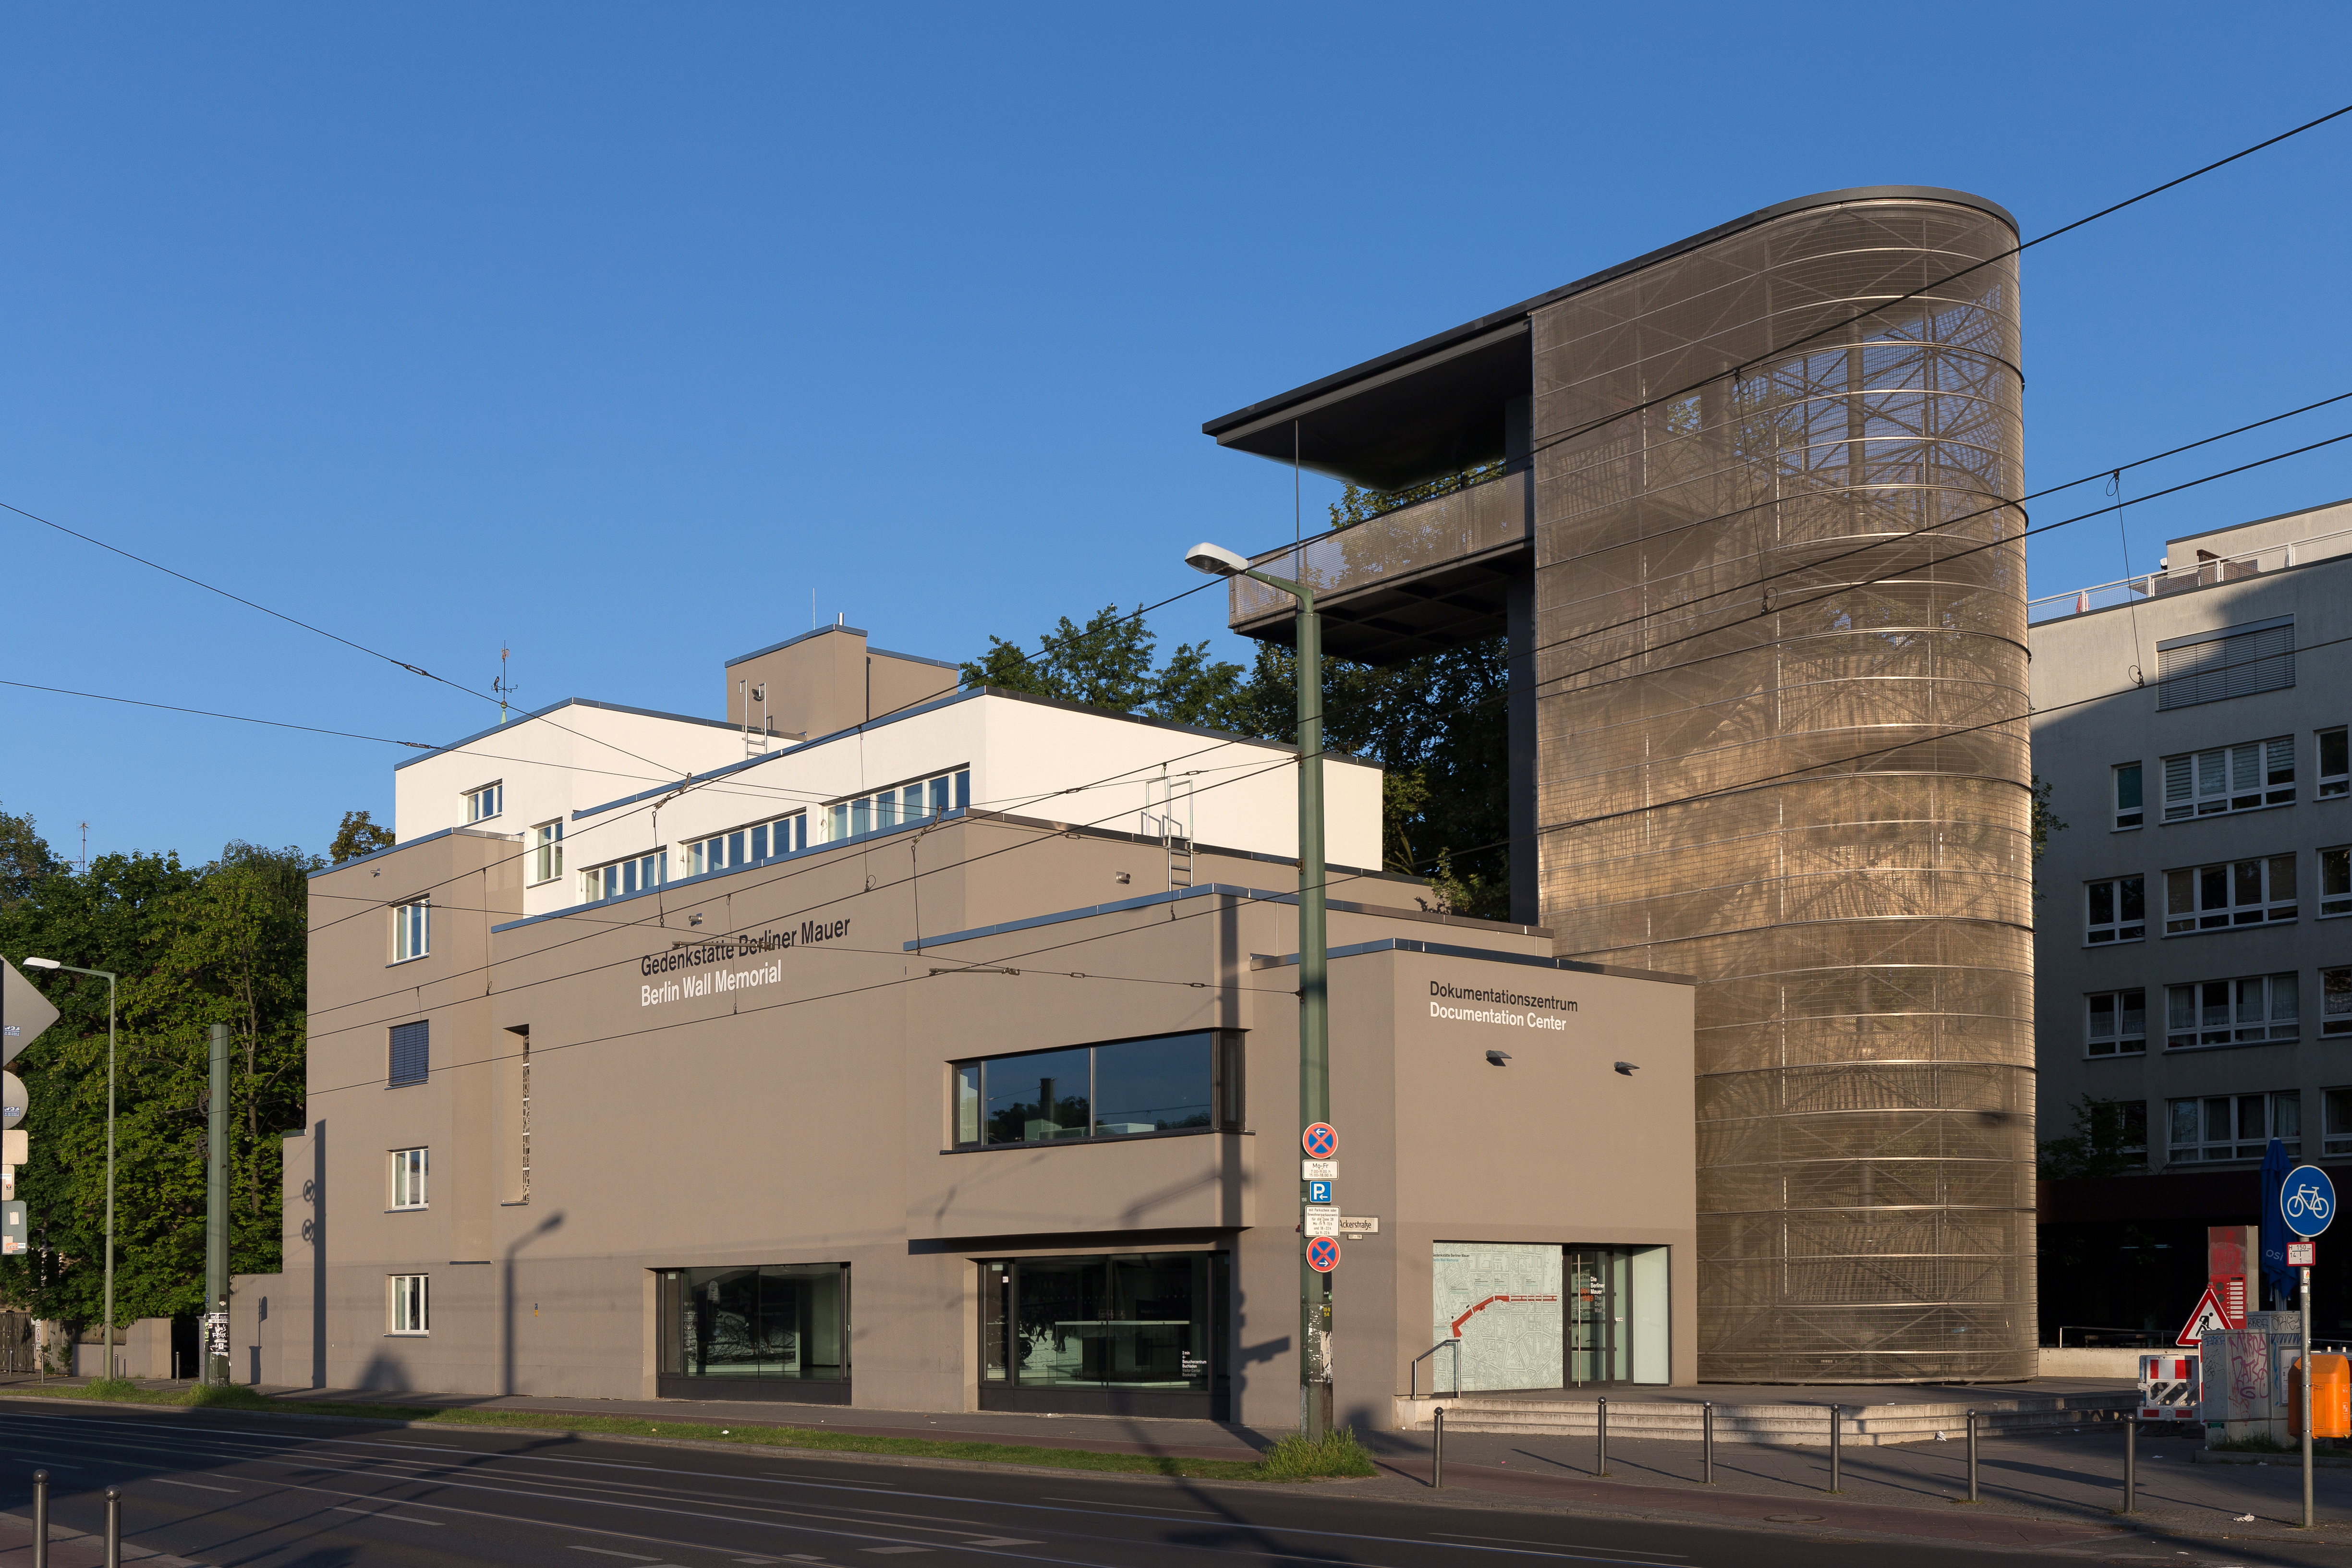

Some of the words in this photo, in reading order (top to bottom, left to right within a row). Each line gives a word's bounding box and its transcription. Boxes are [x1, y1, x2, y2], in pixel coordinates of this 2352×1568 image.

[642, 939, 734, 976] Gedenkstätte
[739, 930, 797, 957] Berliner
[801, 918, 850, 945] Mauer
[642, 981, 679, 1007] Berlin
[683, 972, 711, 998] Wall
[715, 960, 781, 993] Memorial
[1430, 981, 1578, 1012] Dokumentationszentrum
[1430, 1002, 1524, 1026] Documentation
[1527, 1012, 1566, 1031] Center
[1314, 1183, 1325, 1200] P
